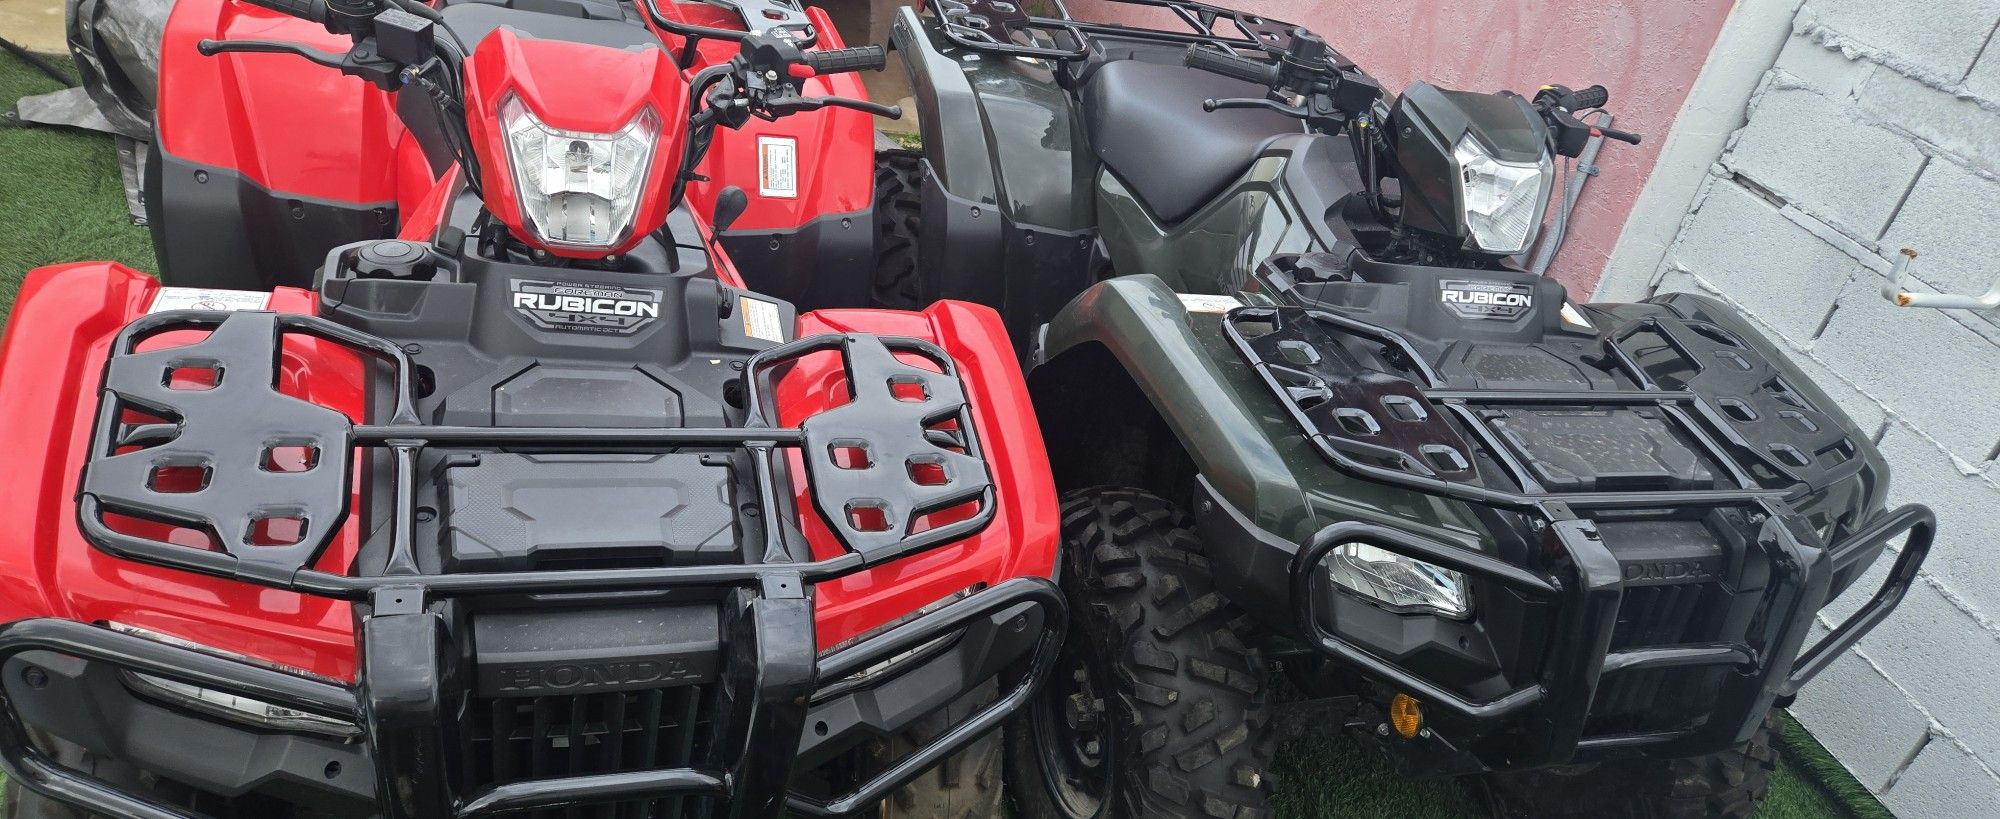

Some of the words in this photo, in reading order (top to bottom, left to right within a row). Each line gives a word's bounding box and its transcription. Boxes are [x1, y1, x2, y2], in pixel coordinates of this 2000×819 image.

[553, 287, 623, 299] FOREMAN
[584, 282, 622, 291] STEERING
[513, 292, 659, 318] RUBICON
[1441, 289, 1532, 308] RUBICON
[555, 324, 602, 333] AUTOMATIC
[1619, 562, 1711, 582] ONDA
[499, 658, 702, 690] HONDA
